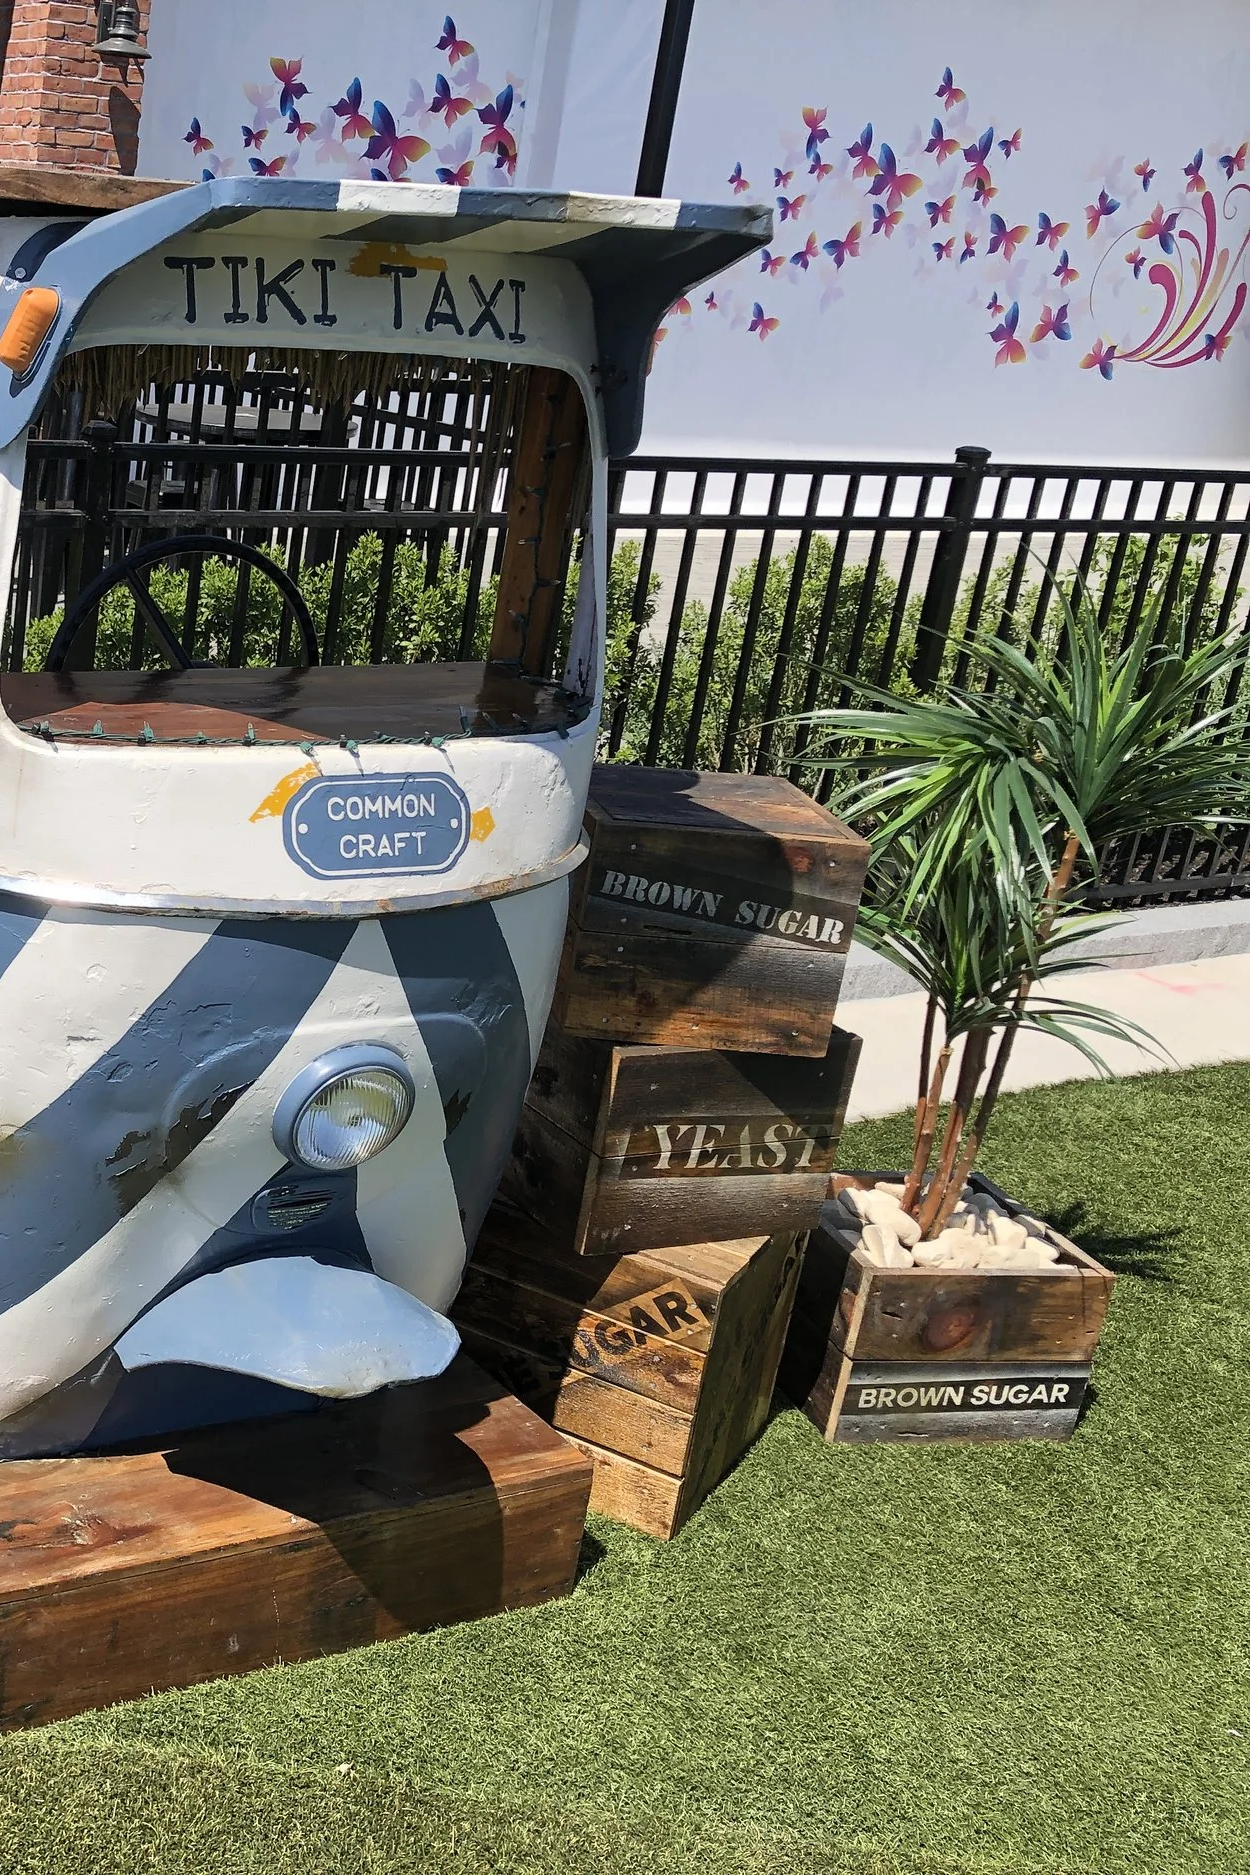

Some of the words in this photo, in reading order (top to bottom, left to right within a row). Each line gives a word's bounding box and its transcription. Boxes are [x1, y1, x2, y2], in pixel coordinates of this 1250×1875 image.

[164, 256, 339, 327] TIKI
[379, 263, 526, 344] TAXI
[327, 793, 436, 821] COMMON
[339, 831, 427, 859] CRAFT
[600, 869, 724, 918] BROWN
[734, 899, 845, 945] SUGAR
[652, 1123, 834, 1170] YEAST
[858, 1386, 965, 1409] BROWN
[969, 1383, 1070, 1405] SUGAR
